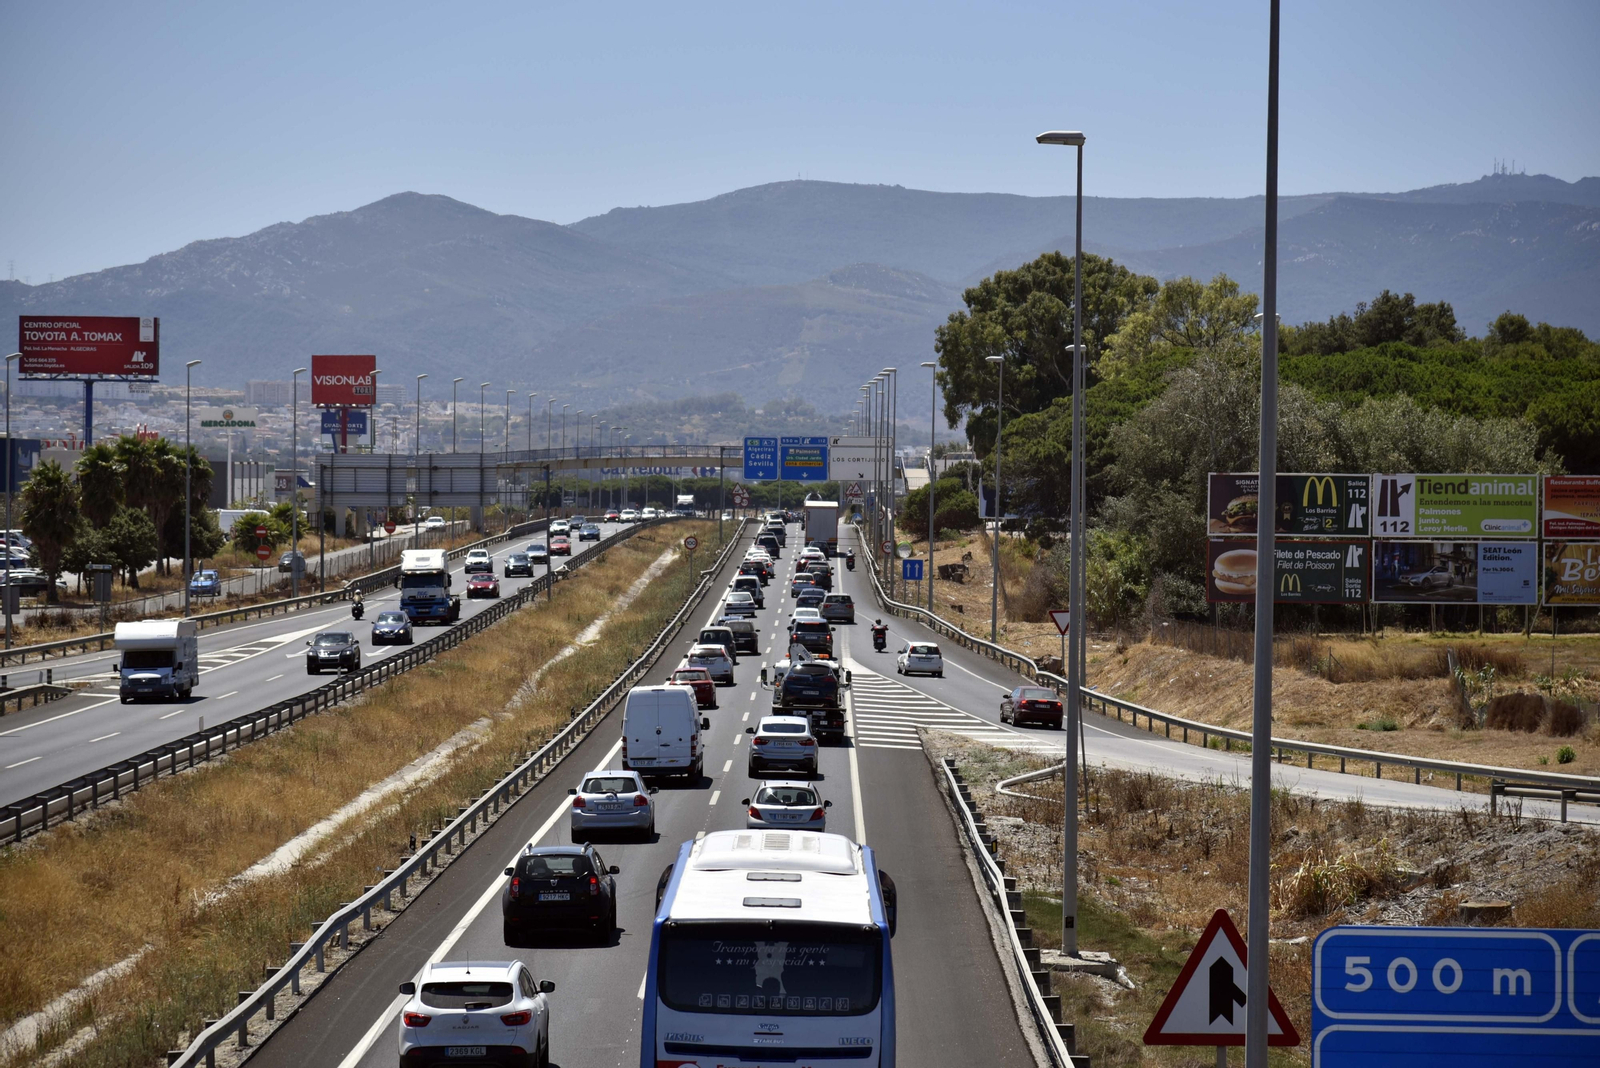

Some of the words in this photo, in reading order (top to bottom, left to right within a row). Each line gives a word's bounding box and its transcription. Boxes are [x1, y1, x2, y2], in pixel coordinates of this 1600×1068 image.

[24, 331, 67, 341] TOYOTA
[70, 332, 82, 341] A.
[83, 332, 123, 342] TOMAX
[141, 362, 154, 370] 109
[314, 375, 372, 385] VISIONLAB
[1417, 479, 1534, 495] Tiendanimal
[1348, 489, 1366, 498] 112
[1419, 498, 1470, 506] Entendemos
[1479, 498, 1491, 506] las
[1418, 517, 1440, 525] junto
[1380, 521, 1409, 532] 112
[1419, 525, 1442, 533] Leroy
[1294, 549, 1305, 559] de
[1306, 549, 1341, 560] Pescado
[1277, 560, 1293, 569] Filet
[1294, 561, 1304, 569] de
[1305, 560, 1335, 570] Poisson
[1345, 589, 1361, 598] 112
[800, 943, 830, 957] gente
[1344, 955, 1463, 995] 500
[1492, 967, 1532, 996] m
[838, 1037, 873, 1045] IVECO
[450, 1047, 468, 1055] 2369
[470, 1047, 484, 1055] KGL
